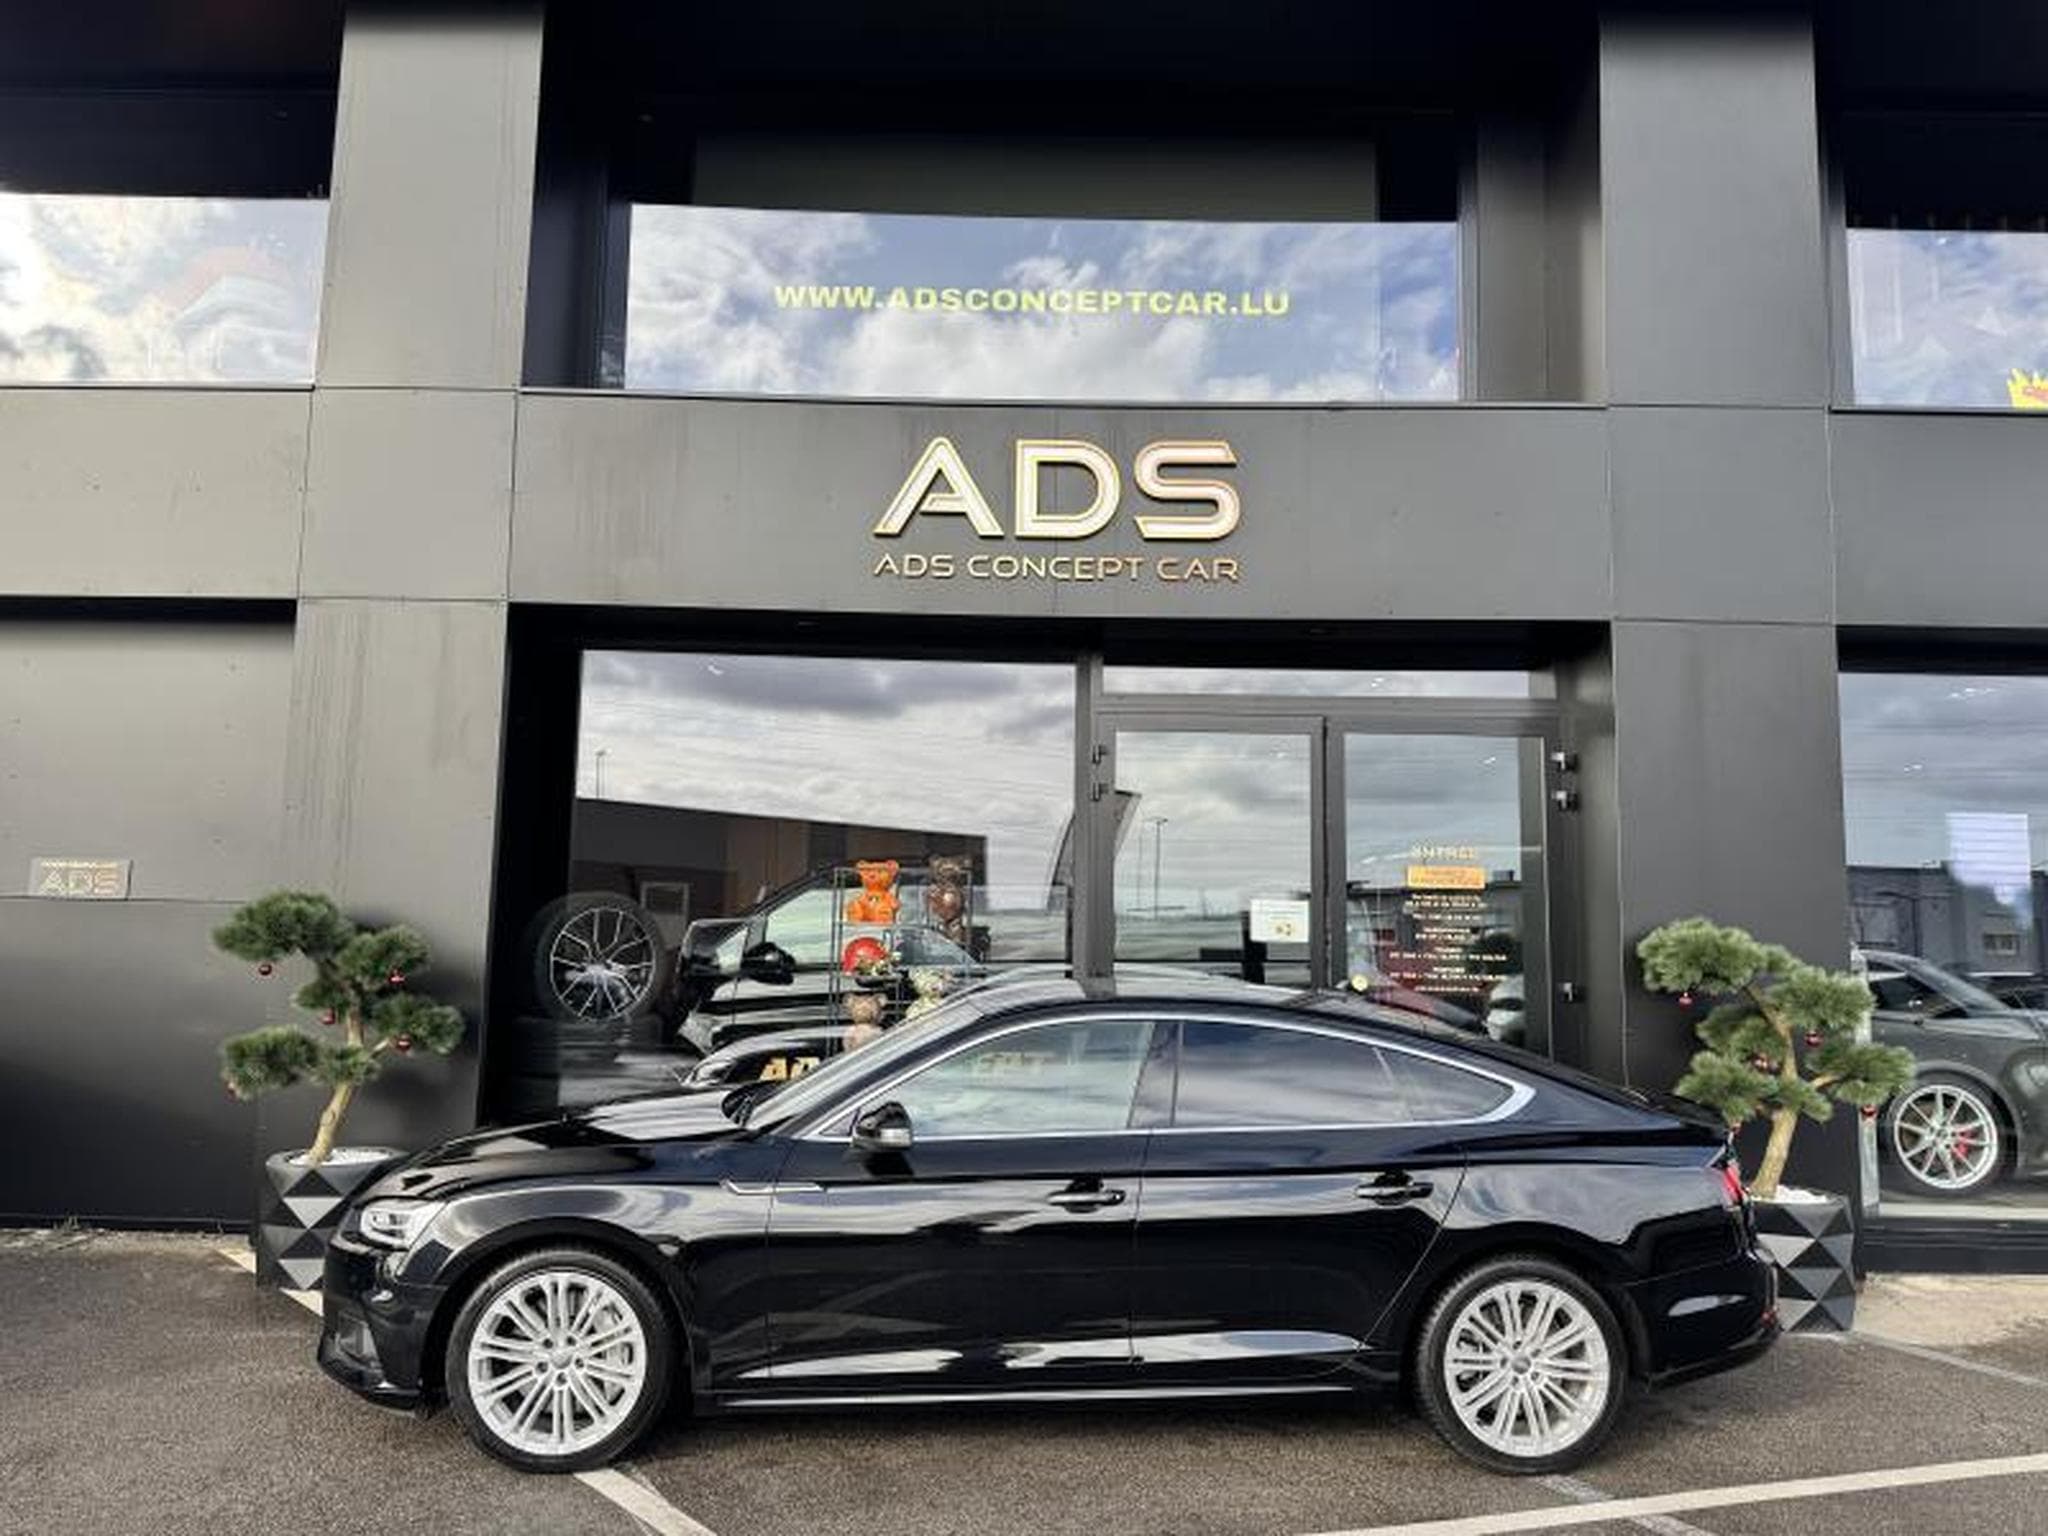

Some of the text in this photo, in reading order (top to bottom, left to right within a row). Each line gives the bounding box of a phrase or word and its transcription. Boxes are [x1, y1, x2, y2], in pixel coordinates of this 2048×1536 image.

[774, 285, 1291, 315] WWW.ADSCONCEPTCAR.LU
[873, 436, 1241, 540] ADS
[873, 553, 1240, 583] ADS CONCEPT CAR
